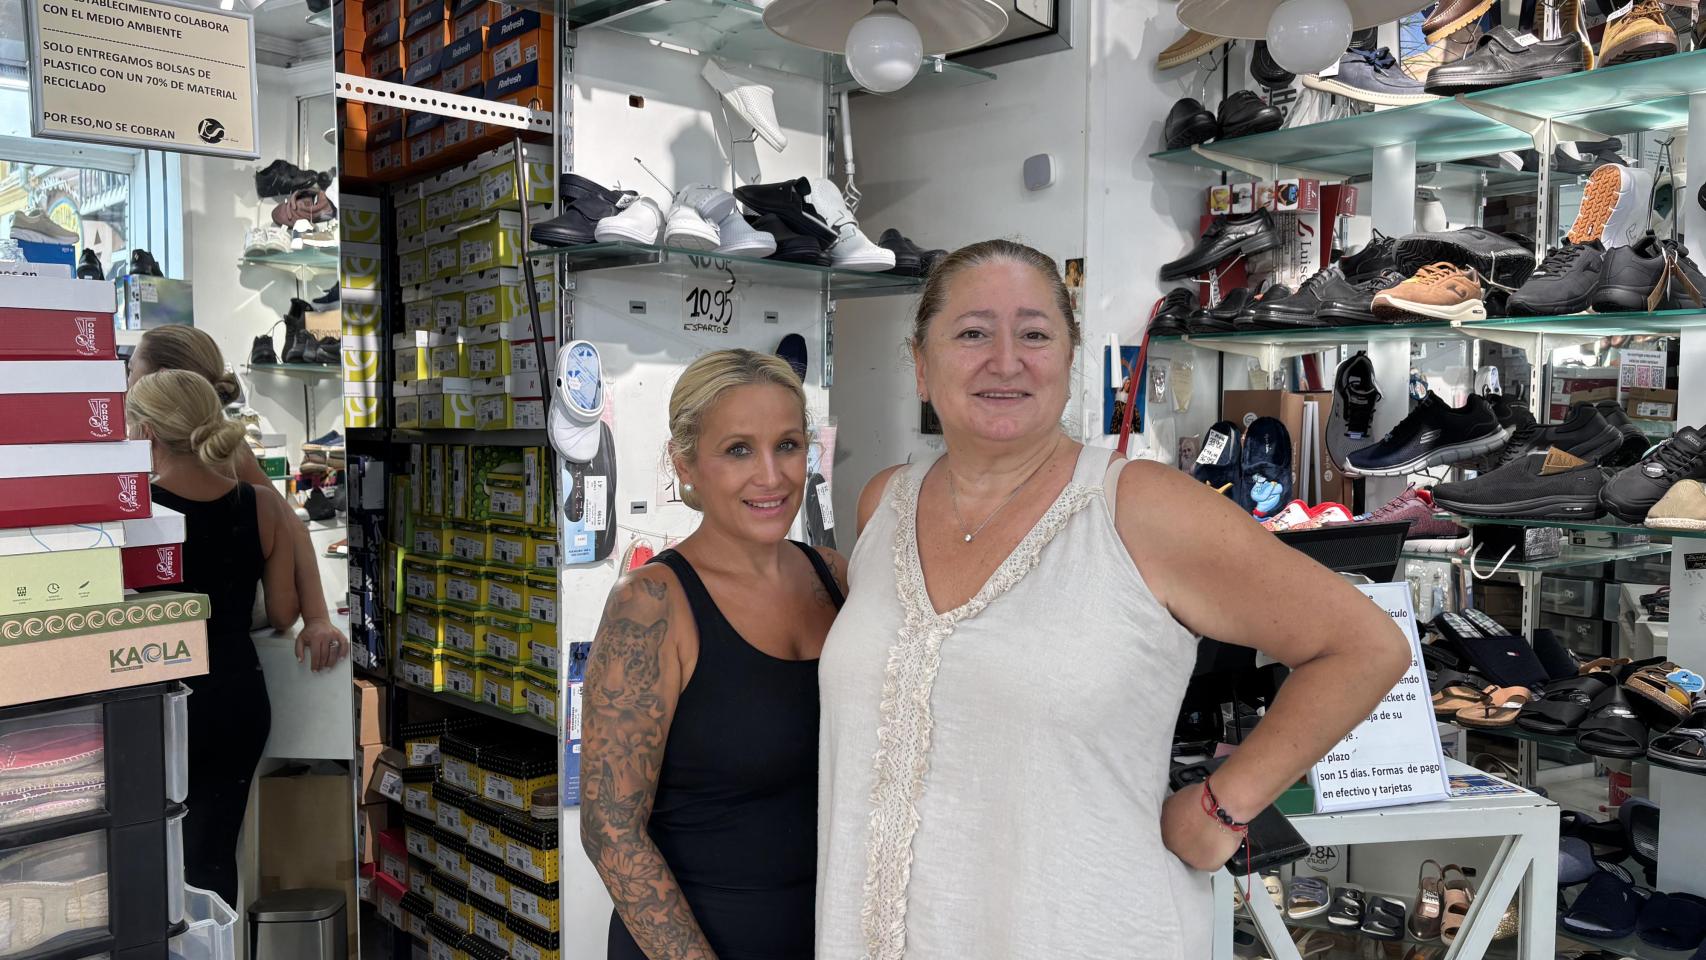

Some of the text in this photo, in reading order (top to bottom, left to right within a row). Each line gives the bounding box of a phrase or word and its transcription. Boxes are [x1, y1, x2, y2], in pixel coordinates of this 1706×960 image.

[43, 4, 182, 39] CON EL MEDIO AMBIENTE
[74, 0, 229, 33] ABLECIMIENTO COLABORA
[501, 17, 524, 34] Refresh
[43, 41, 211, 79] SOLO ENTREGAMOS BOLSAS DE
[43, 58, 237, 100] PLASTICO CON UN 70% DE MATERIAL
[43, 76, 106, 93] RECICLADO
[498, 73, 521, 89] Refresh
[44, 112, 175, 139] POR ESO,NO SE COBRAN
[686, 287, 733, 326] 10.95
[684, 323, 728, 334] ESPARTOS
[1406, 691, 1416, 701] de
[1380, 710, 1391, 720] de
[1392, 711, 1402, 719] su
[1328, 752, 1350, 764] plazo
[1320, 773, 1336, 781] son
[1338, 769, 1348, 780] 15
[1371, 766, 1404, 776] Formas
[1407, 763, 1418, 773] de
[1420, 764, 1440, 774] pago
[1322, 783, 1413, 799] en efectivo y tarjetas
